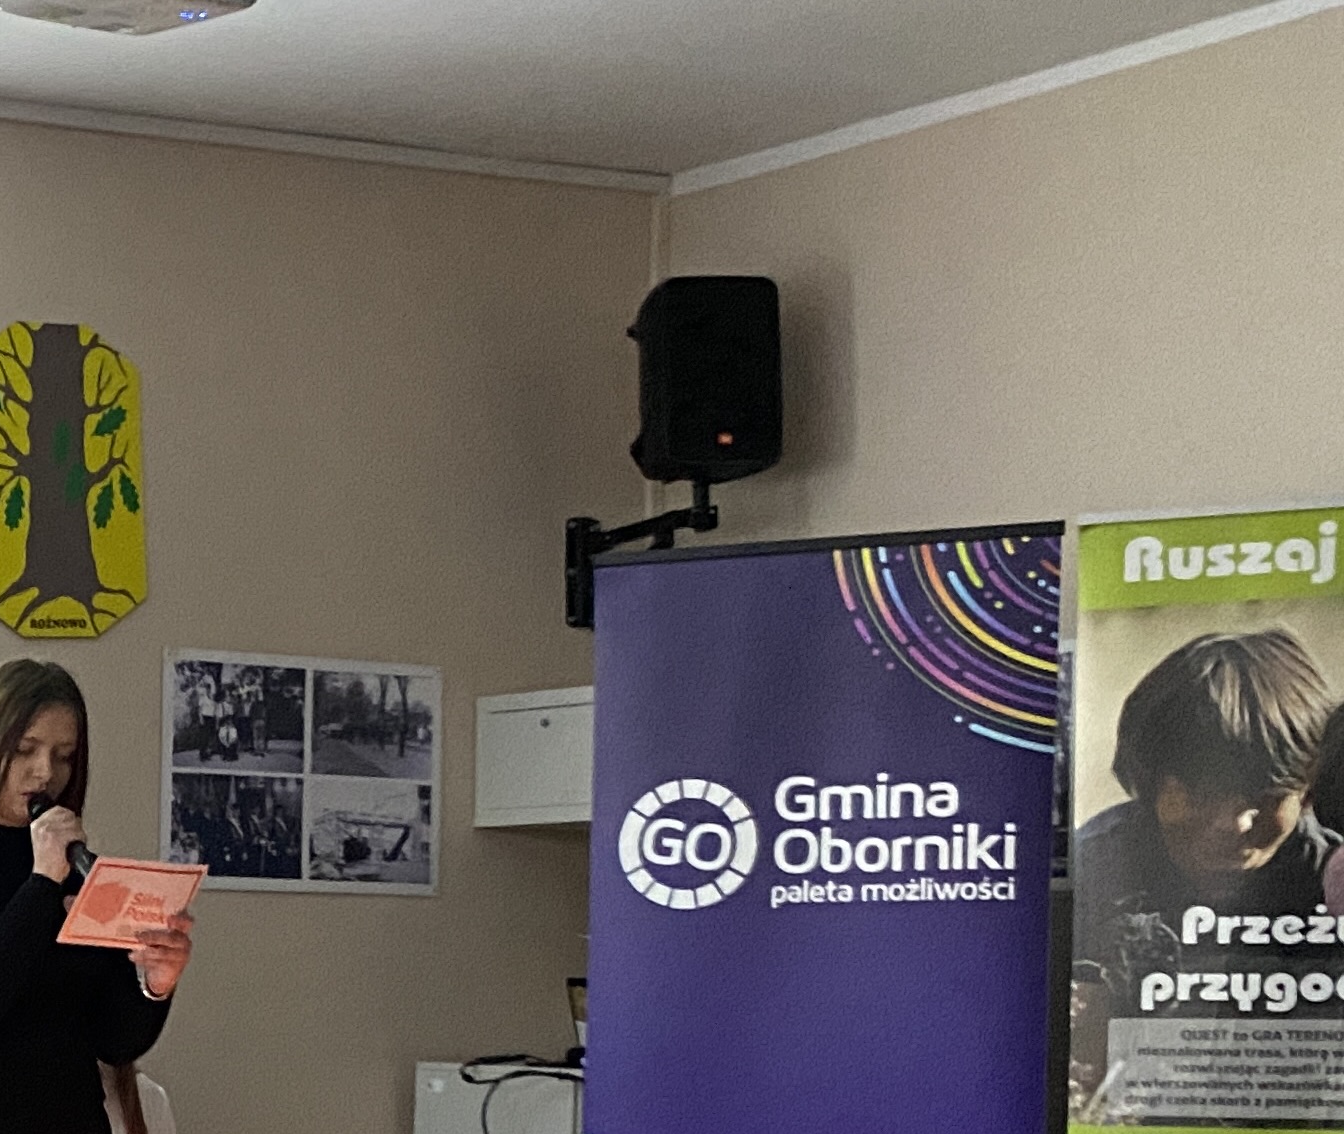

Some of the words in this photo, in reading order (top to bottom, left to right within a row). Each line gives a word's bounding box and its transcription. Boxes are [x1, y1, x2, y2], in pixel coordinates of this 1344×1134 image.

[1123, 520, 1338, 584] Ruszaj
[30, 616, 87, 629] ROŻNOWO
[774, 773, 959, 822] Gmina
[641, 818, 732, 871] GO
[773, 823, 1017, 874] Oborniki
[771, 879, 853, 908] paleta
[861, 876, 1015, 903] możliwości
[1181, 904, 1344, 945] Przeż
[1140, 972, 1344, 1012] przygo
[1180, 1030, 1227, 1041] QUEST
[1252, 1031, 1283, 1041] GRA
